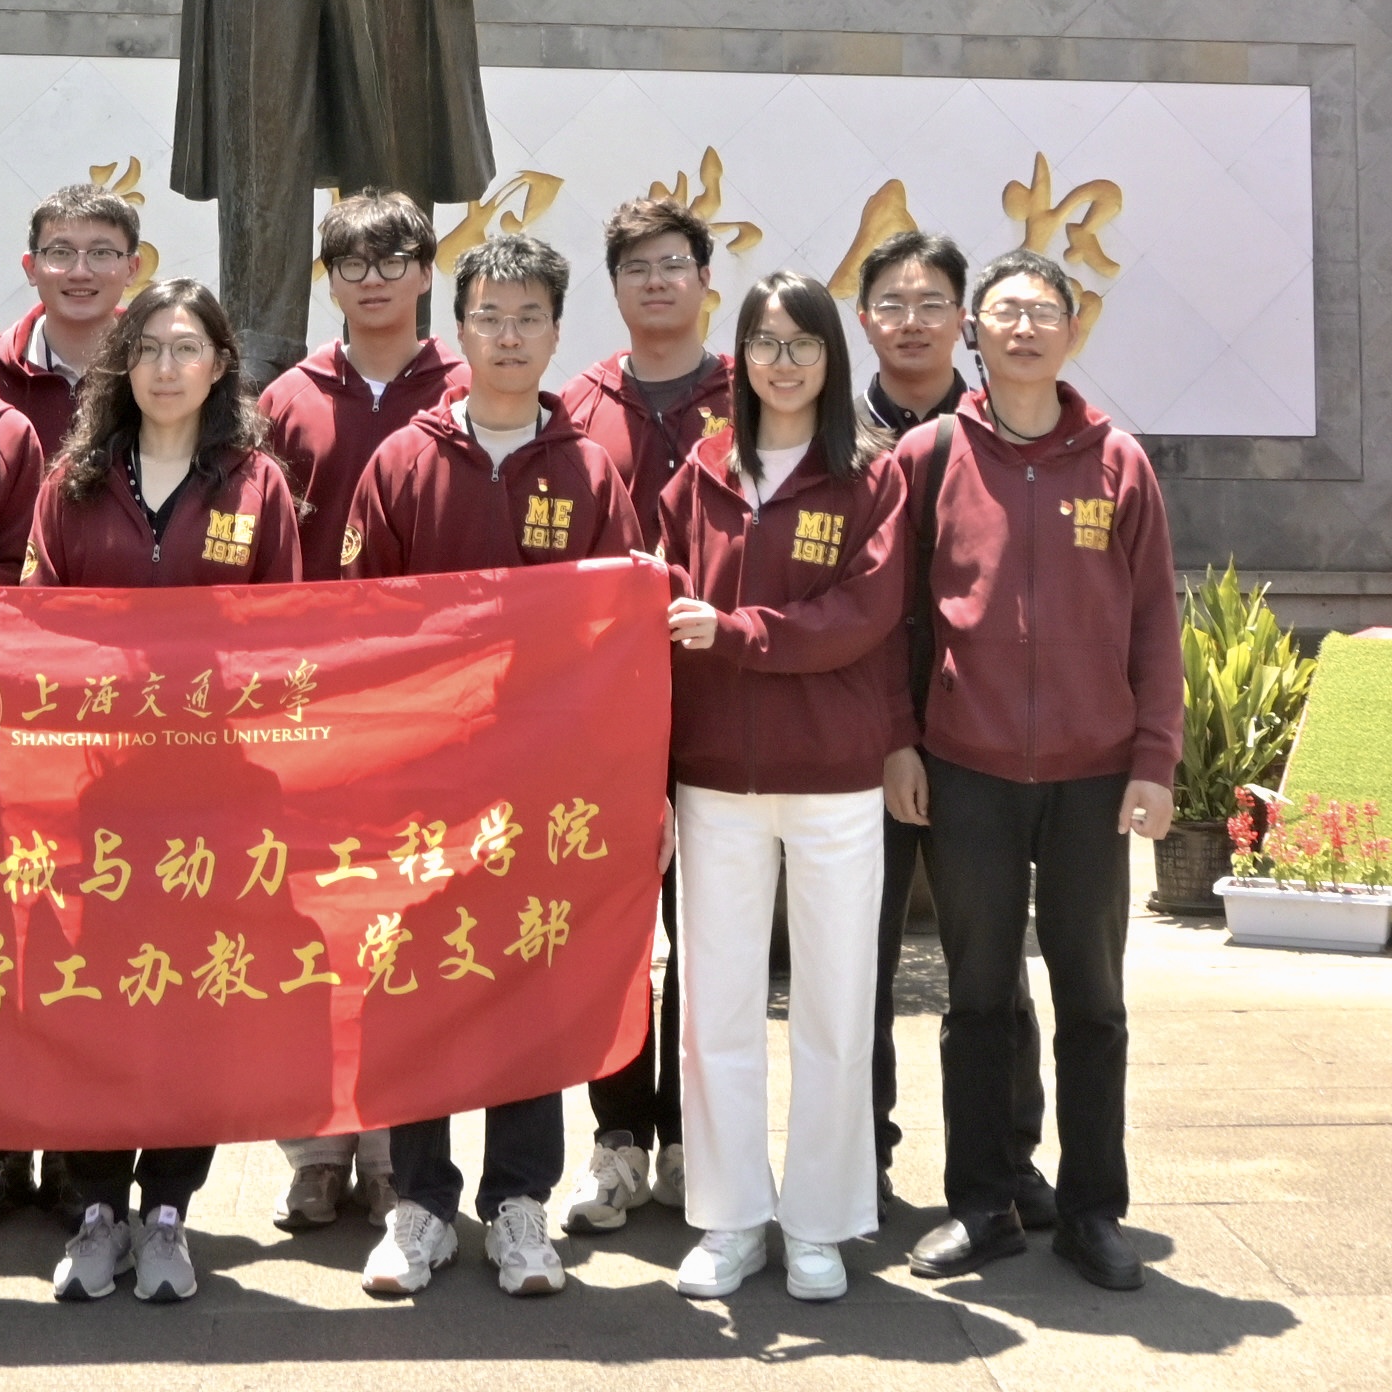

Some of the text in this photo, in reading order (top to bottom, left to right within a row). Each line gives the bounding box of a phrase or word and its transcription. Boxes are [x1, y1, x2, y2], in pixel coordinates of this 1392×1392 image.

[207, 509, 255, 544] ME
[525, 495, 573, 528] ME
[1074, 499, 1115, 529] ME
[795, 510, 844, 544] ME
[202, 538, 250, 566] 1913
[792, 539, 838, 567] 1913
[11, 726, 331, 750] SHANGHAI JIAO TONG UNIVERSITY
